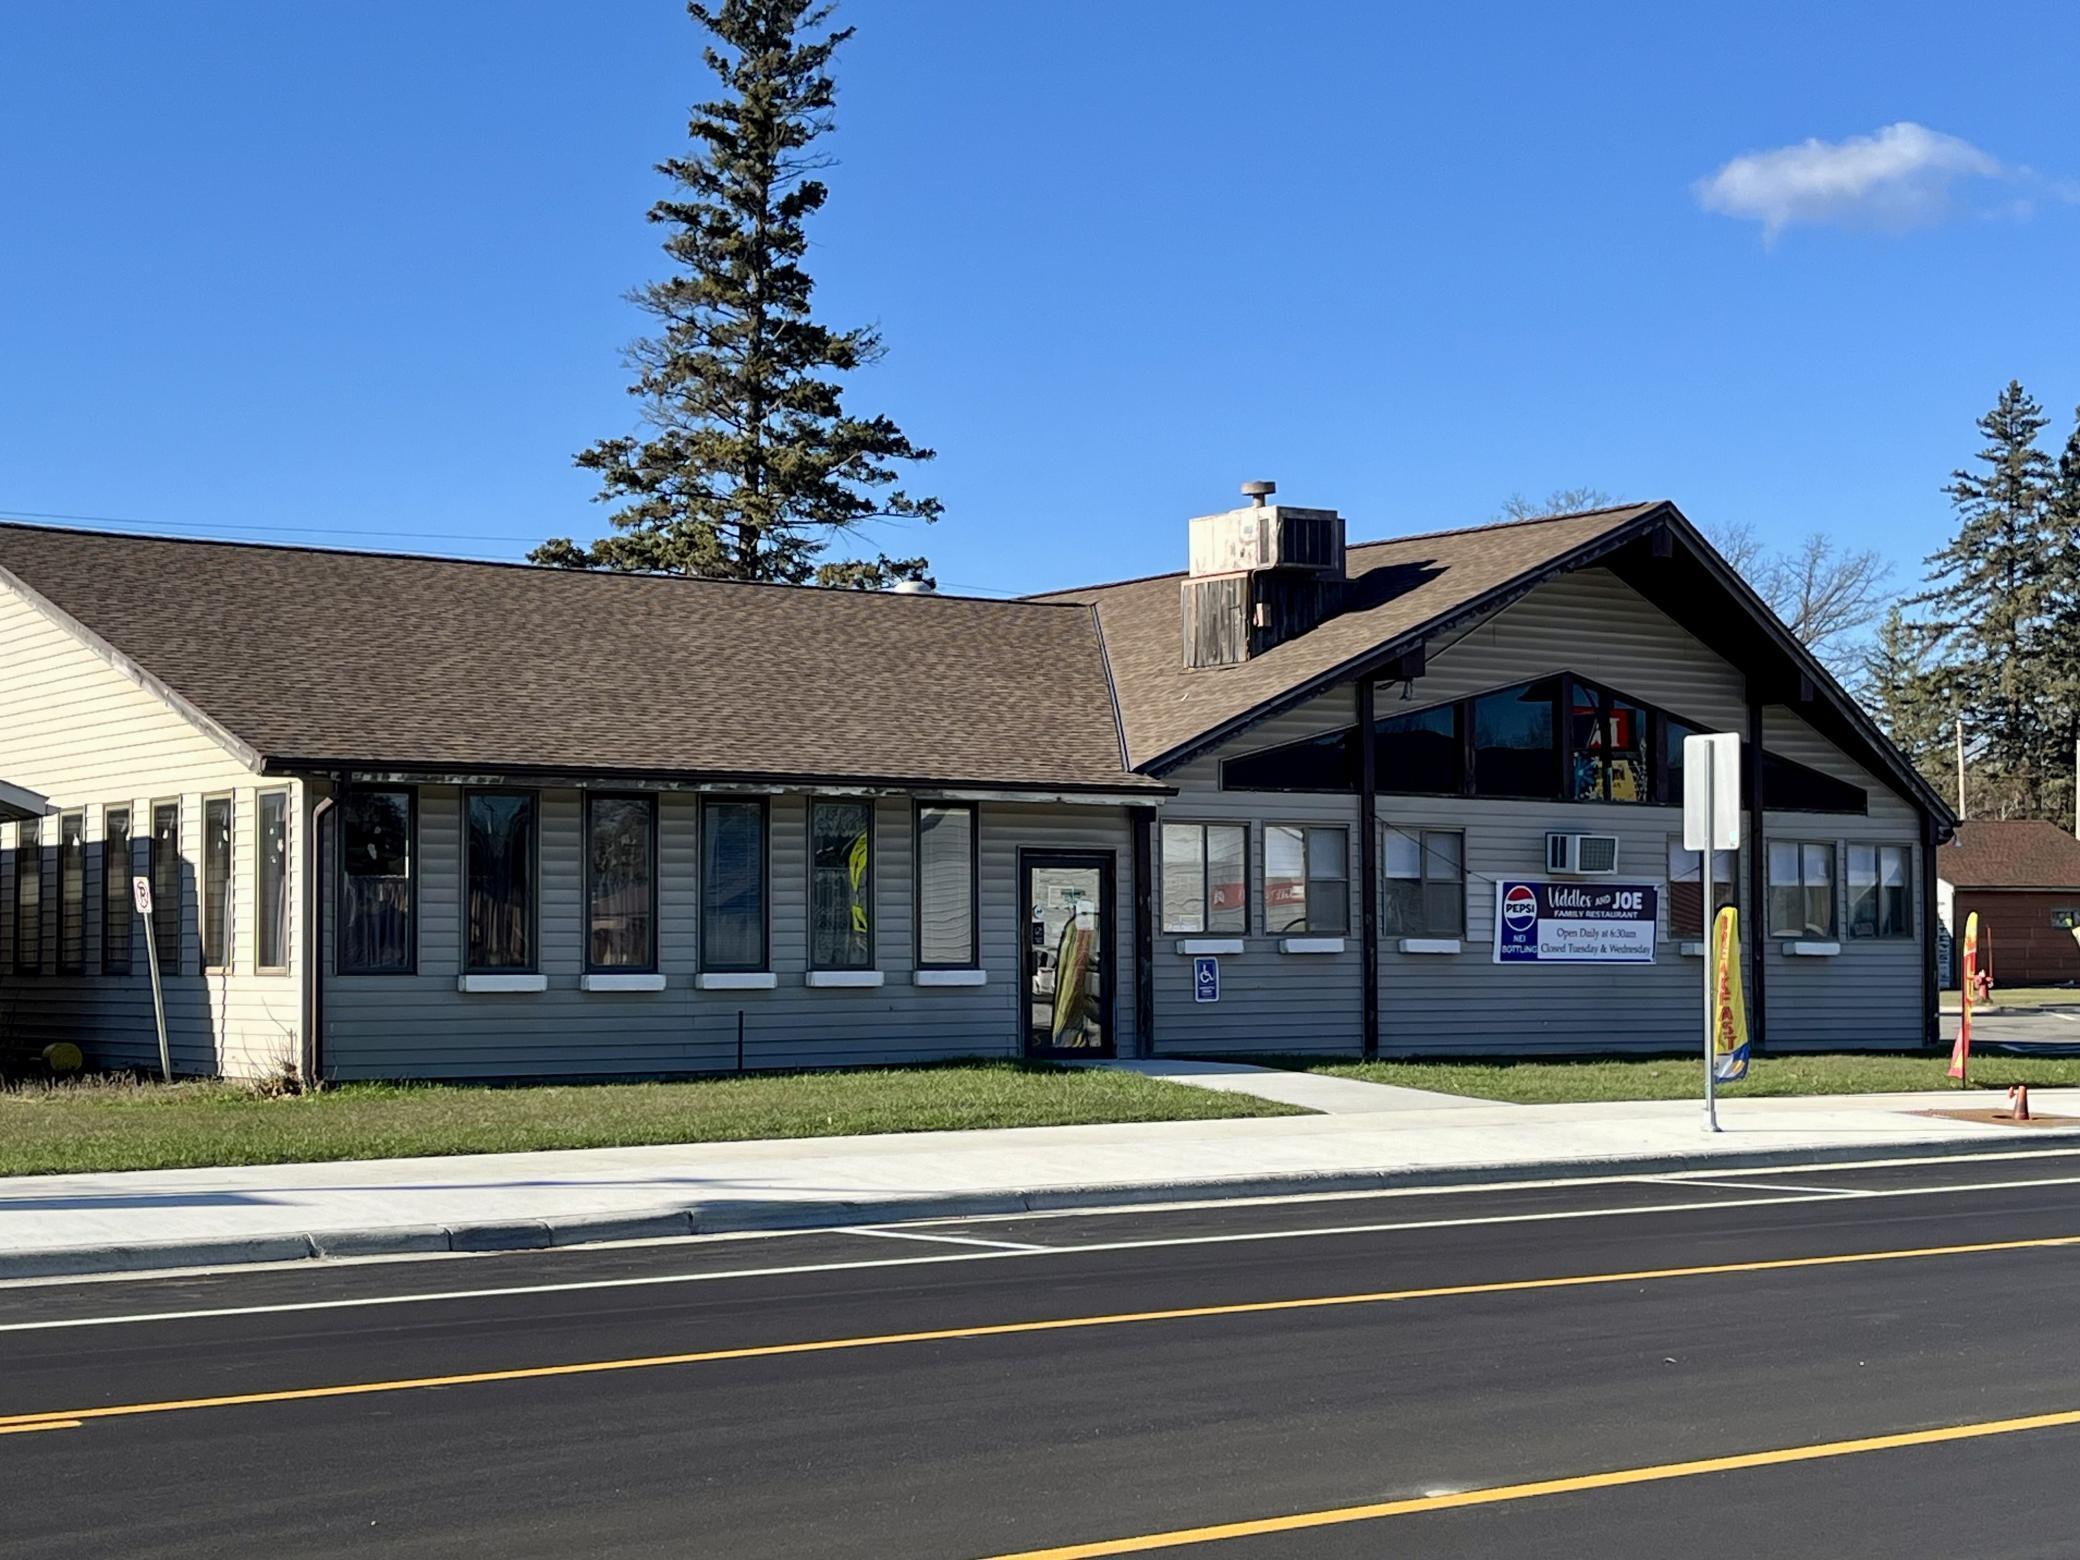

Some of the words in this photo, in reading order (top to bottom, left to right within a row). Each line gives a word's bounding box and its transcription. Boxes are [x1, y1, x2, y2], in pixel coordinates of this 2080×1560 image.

[1595, 894, 1611, 906] AND
[1612, 891, 1642, 910] JOE
[1506, 903, 1535, 914] PEPSI
[1554, 910, 1584, 918] FAMILY
[1585, 910, 1638, 919] RESTAURANT
[1513, 934, 1526, 942] NEI
[1556, 928, 1577, 940] Open
[1579, 928, 1599, 940] Daily
[1601, 929, 1608, 938] at
[1609, 928, 1636, 938] 6:30am
[1502, 945, 1537, 954] BOTTLING
[1541, 943, 1566, 953] Closed
[1568, 943, 1598, 956] Tuesday
[1600, 944, 1607, 953] &
[1609, 944, 1650, 956] Wednesday
[1719, 915, 1737, 1051] BREAKFAST
